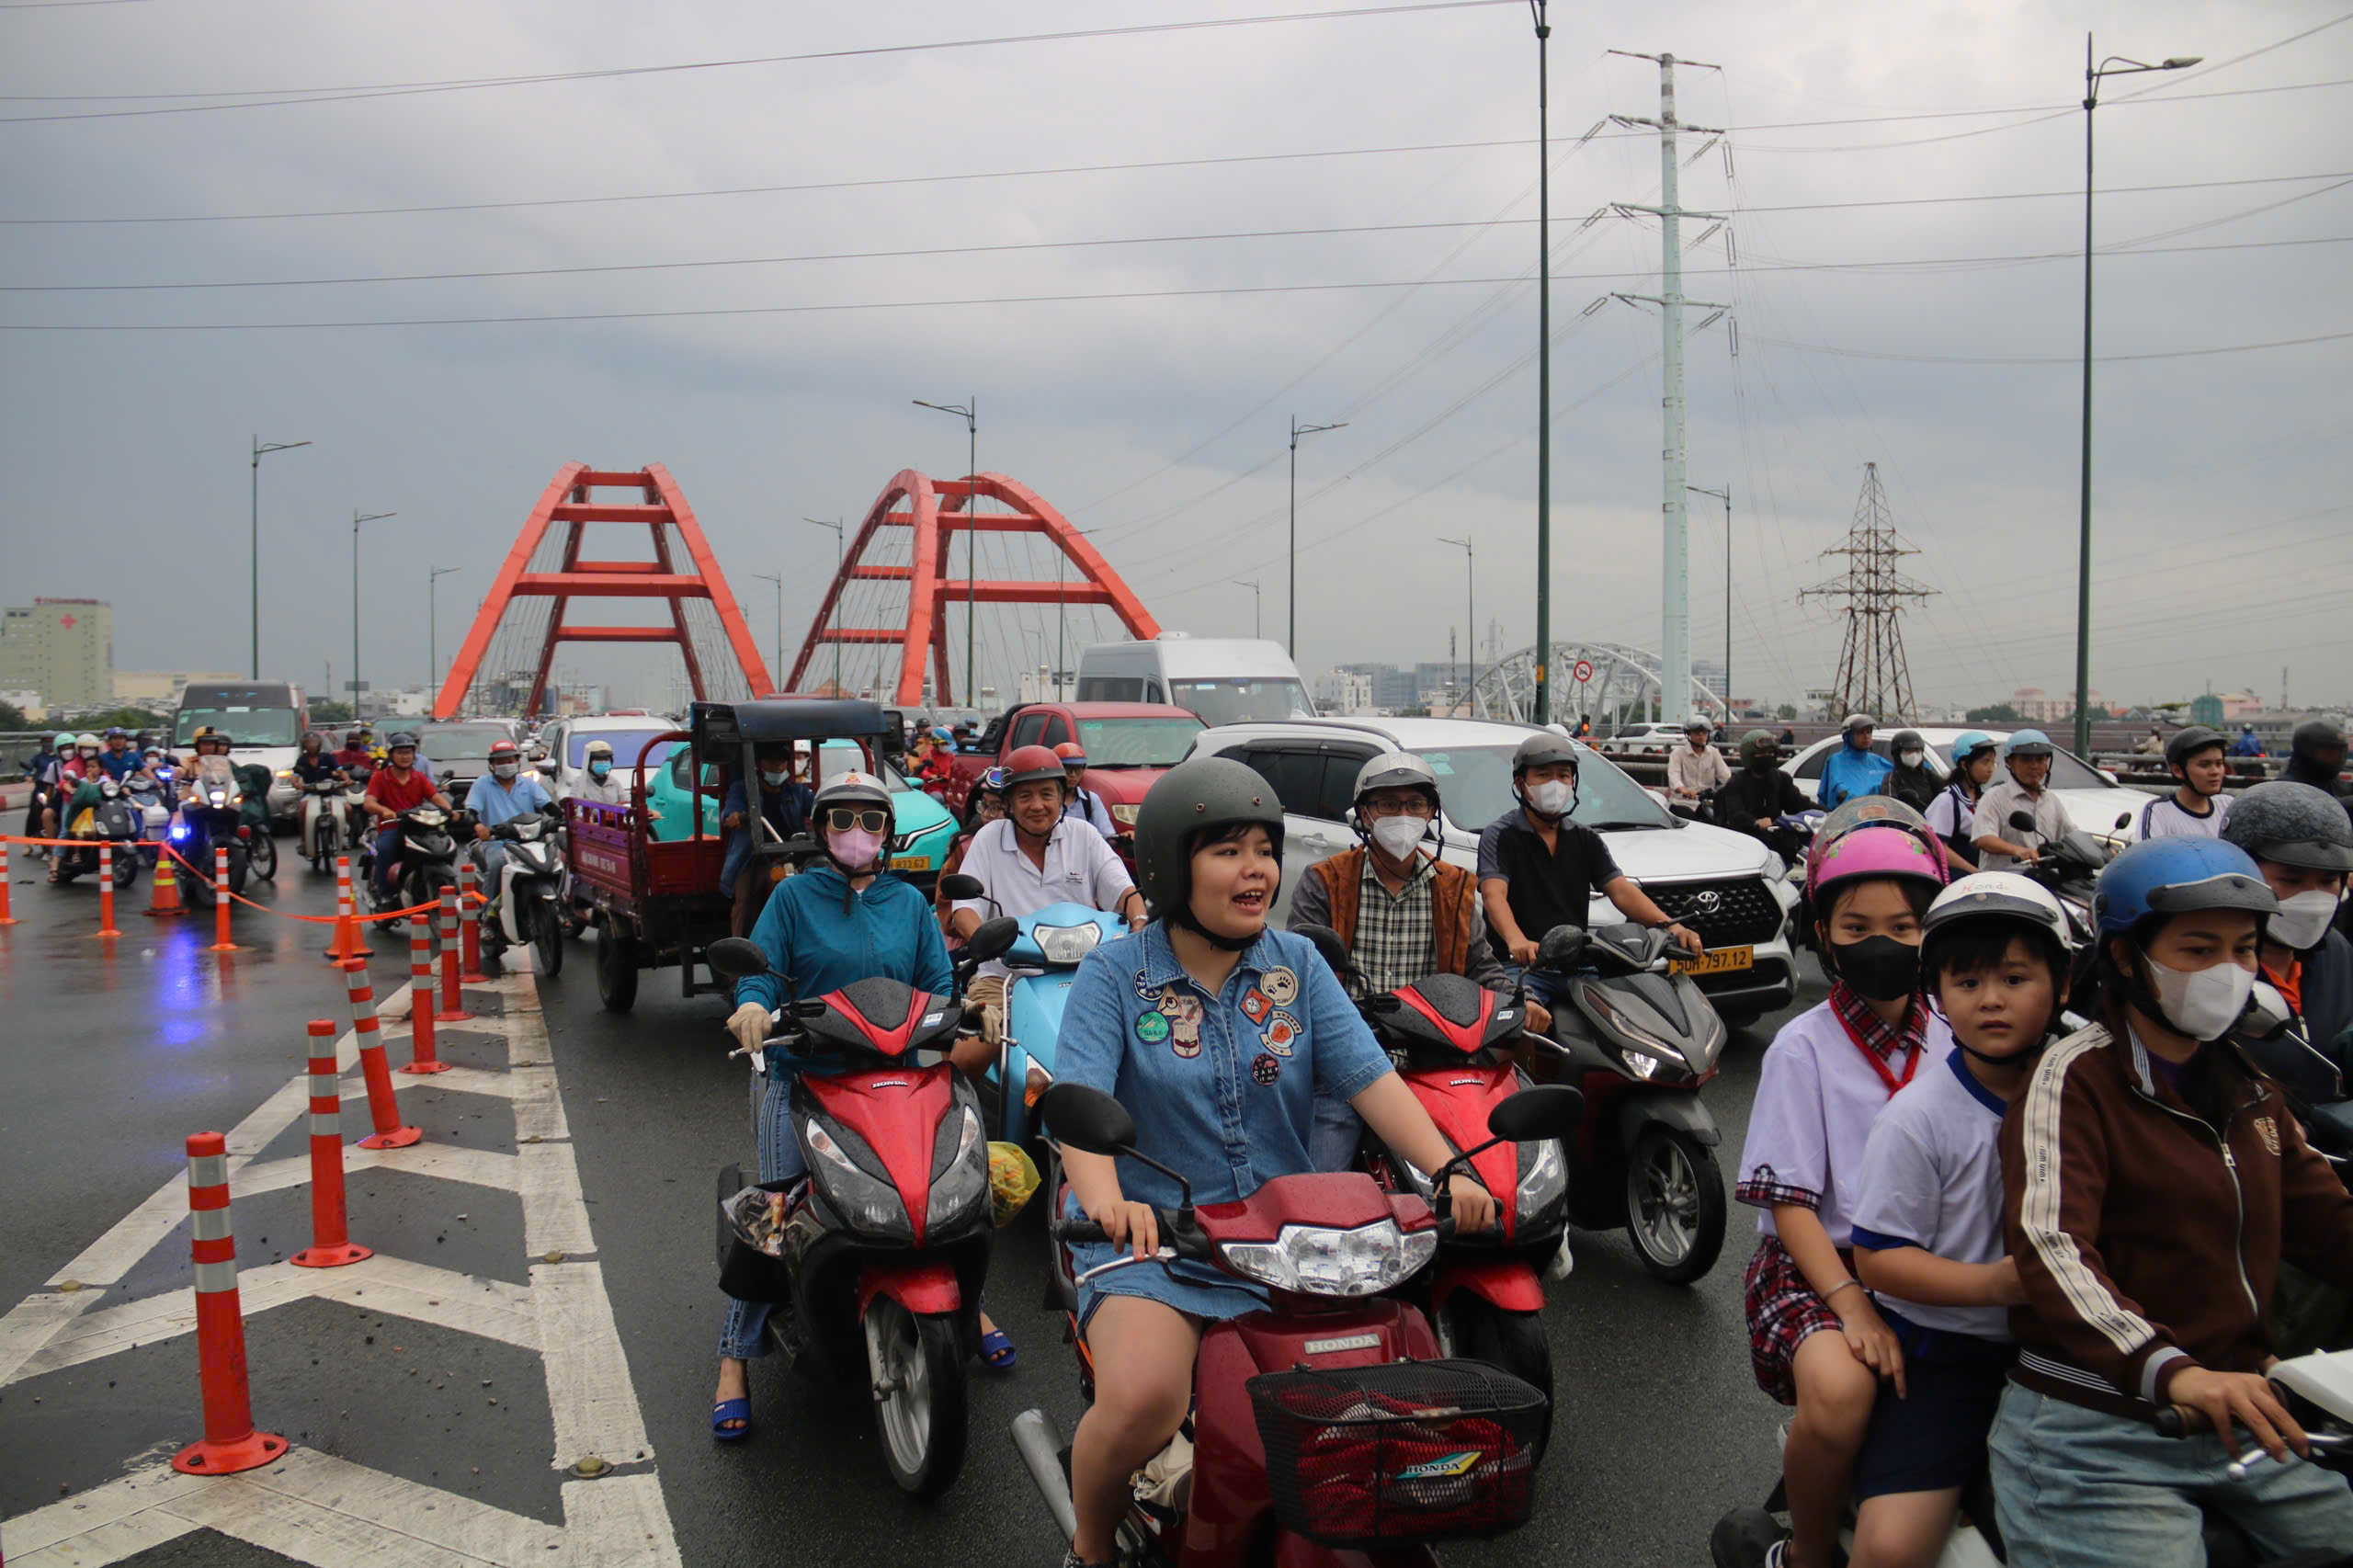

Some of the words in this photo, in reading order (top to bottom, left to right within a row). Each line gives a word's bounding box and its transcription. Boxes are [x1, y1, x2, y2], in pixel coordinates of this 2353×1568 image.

[1254, 1066, 1279, 1076] CAMP
[872, 1080, 908, 1088] HONDA
[1307, 1335, 1377, 1352] HONDA
[1406, 1462, 1461, 1473] HONDA
